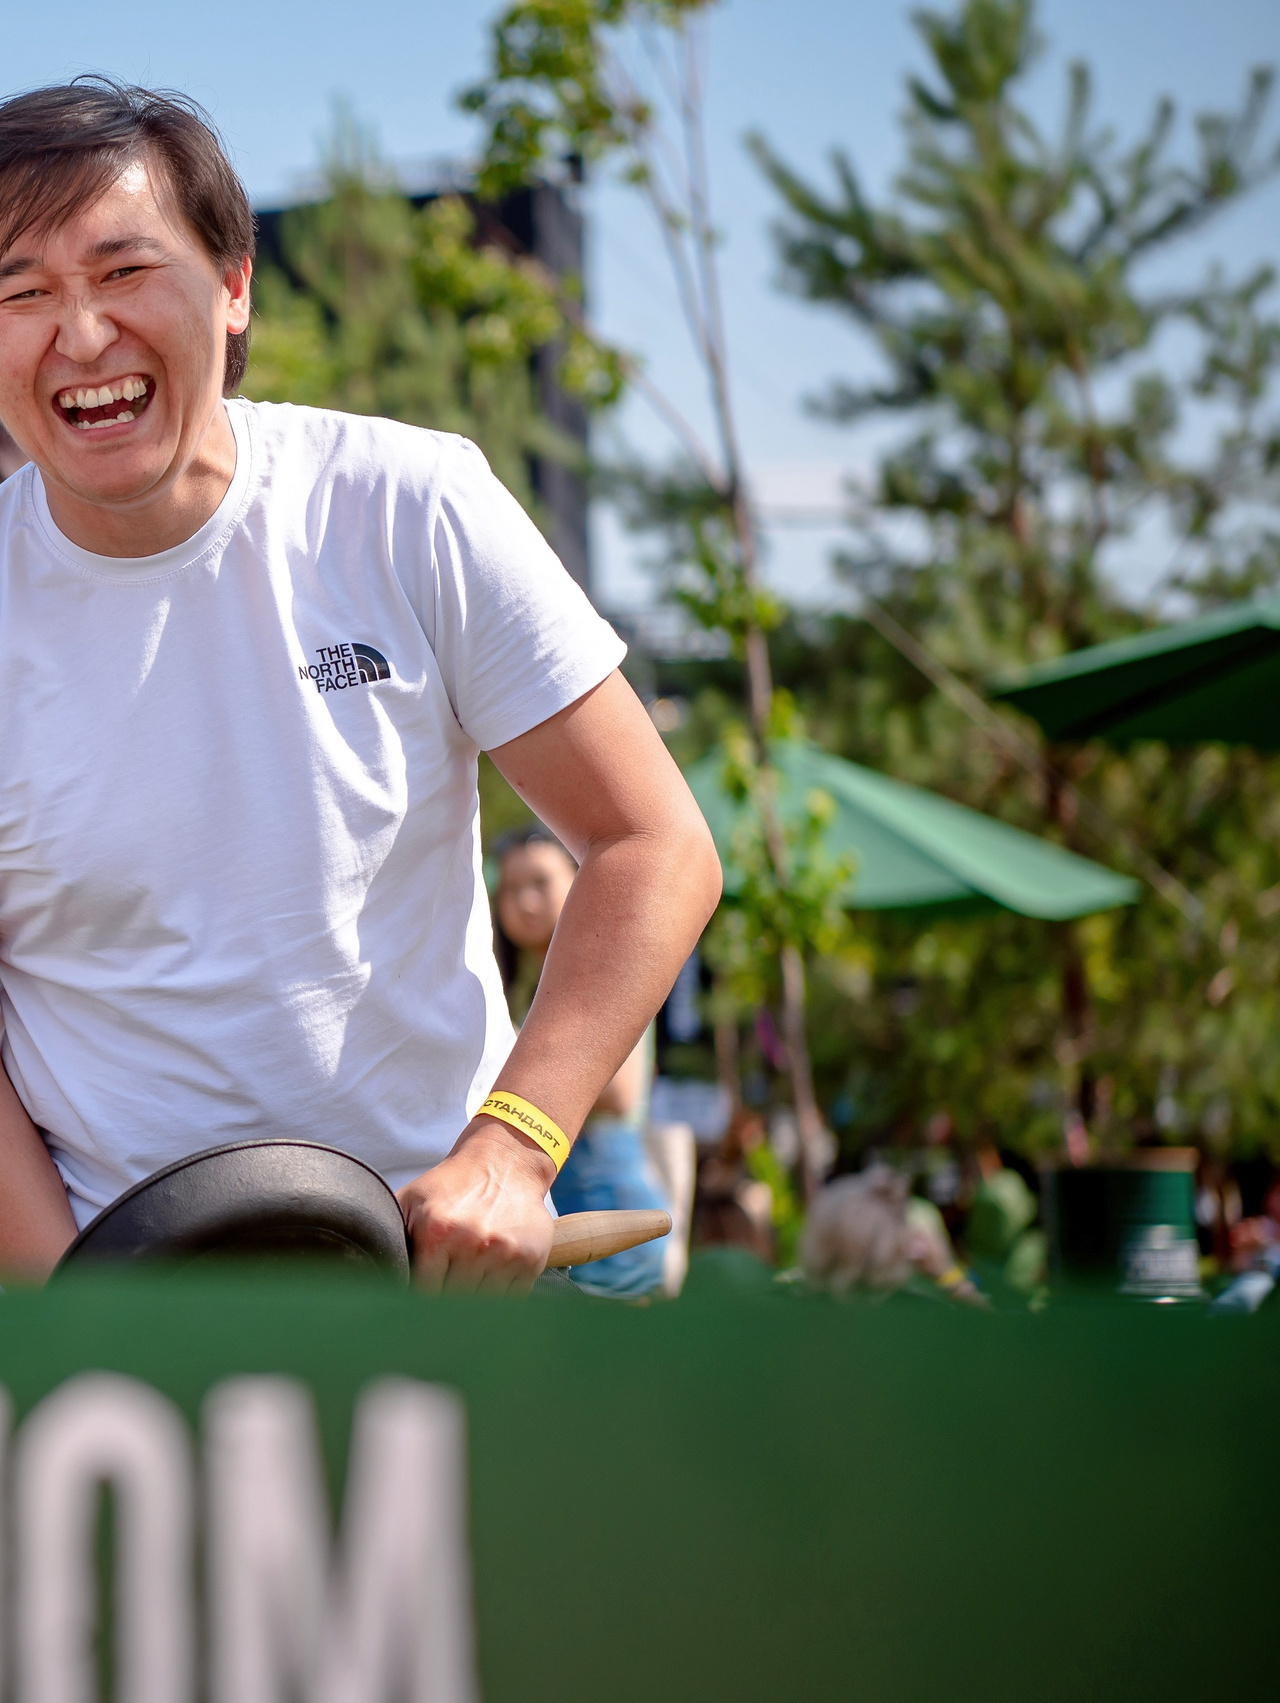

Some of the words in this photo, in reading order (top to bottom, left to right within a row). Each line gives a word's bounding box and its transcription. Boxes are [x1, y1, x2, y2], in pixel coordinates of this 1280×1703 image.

[316, 643, 352, 662] THE
[298, 657, 356, 680] NORTH
[315, 672, 359, 693] FACE
[483, 1100, 561, 1149] СТАНДАРТ
